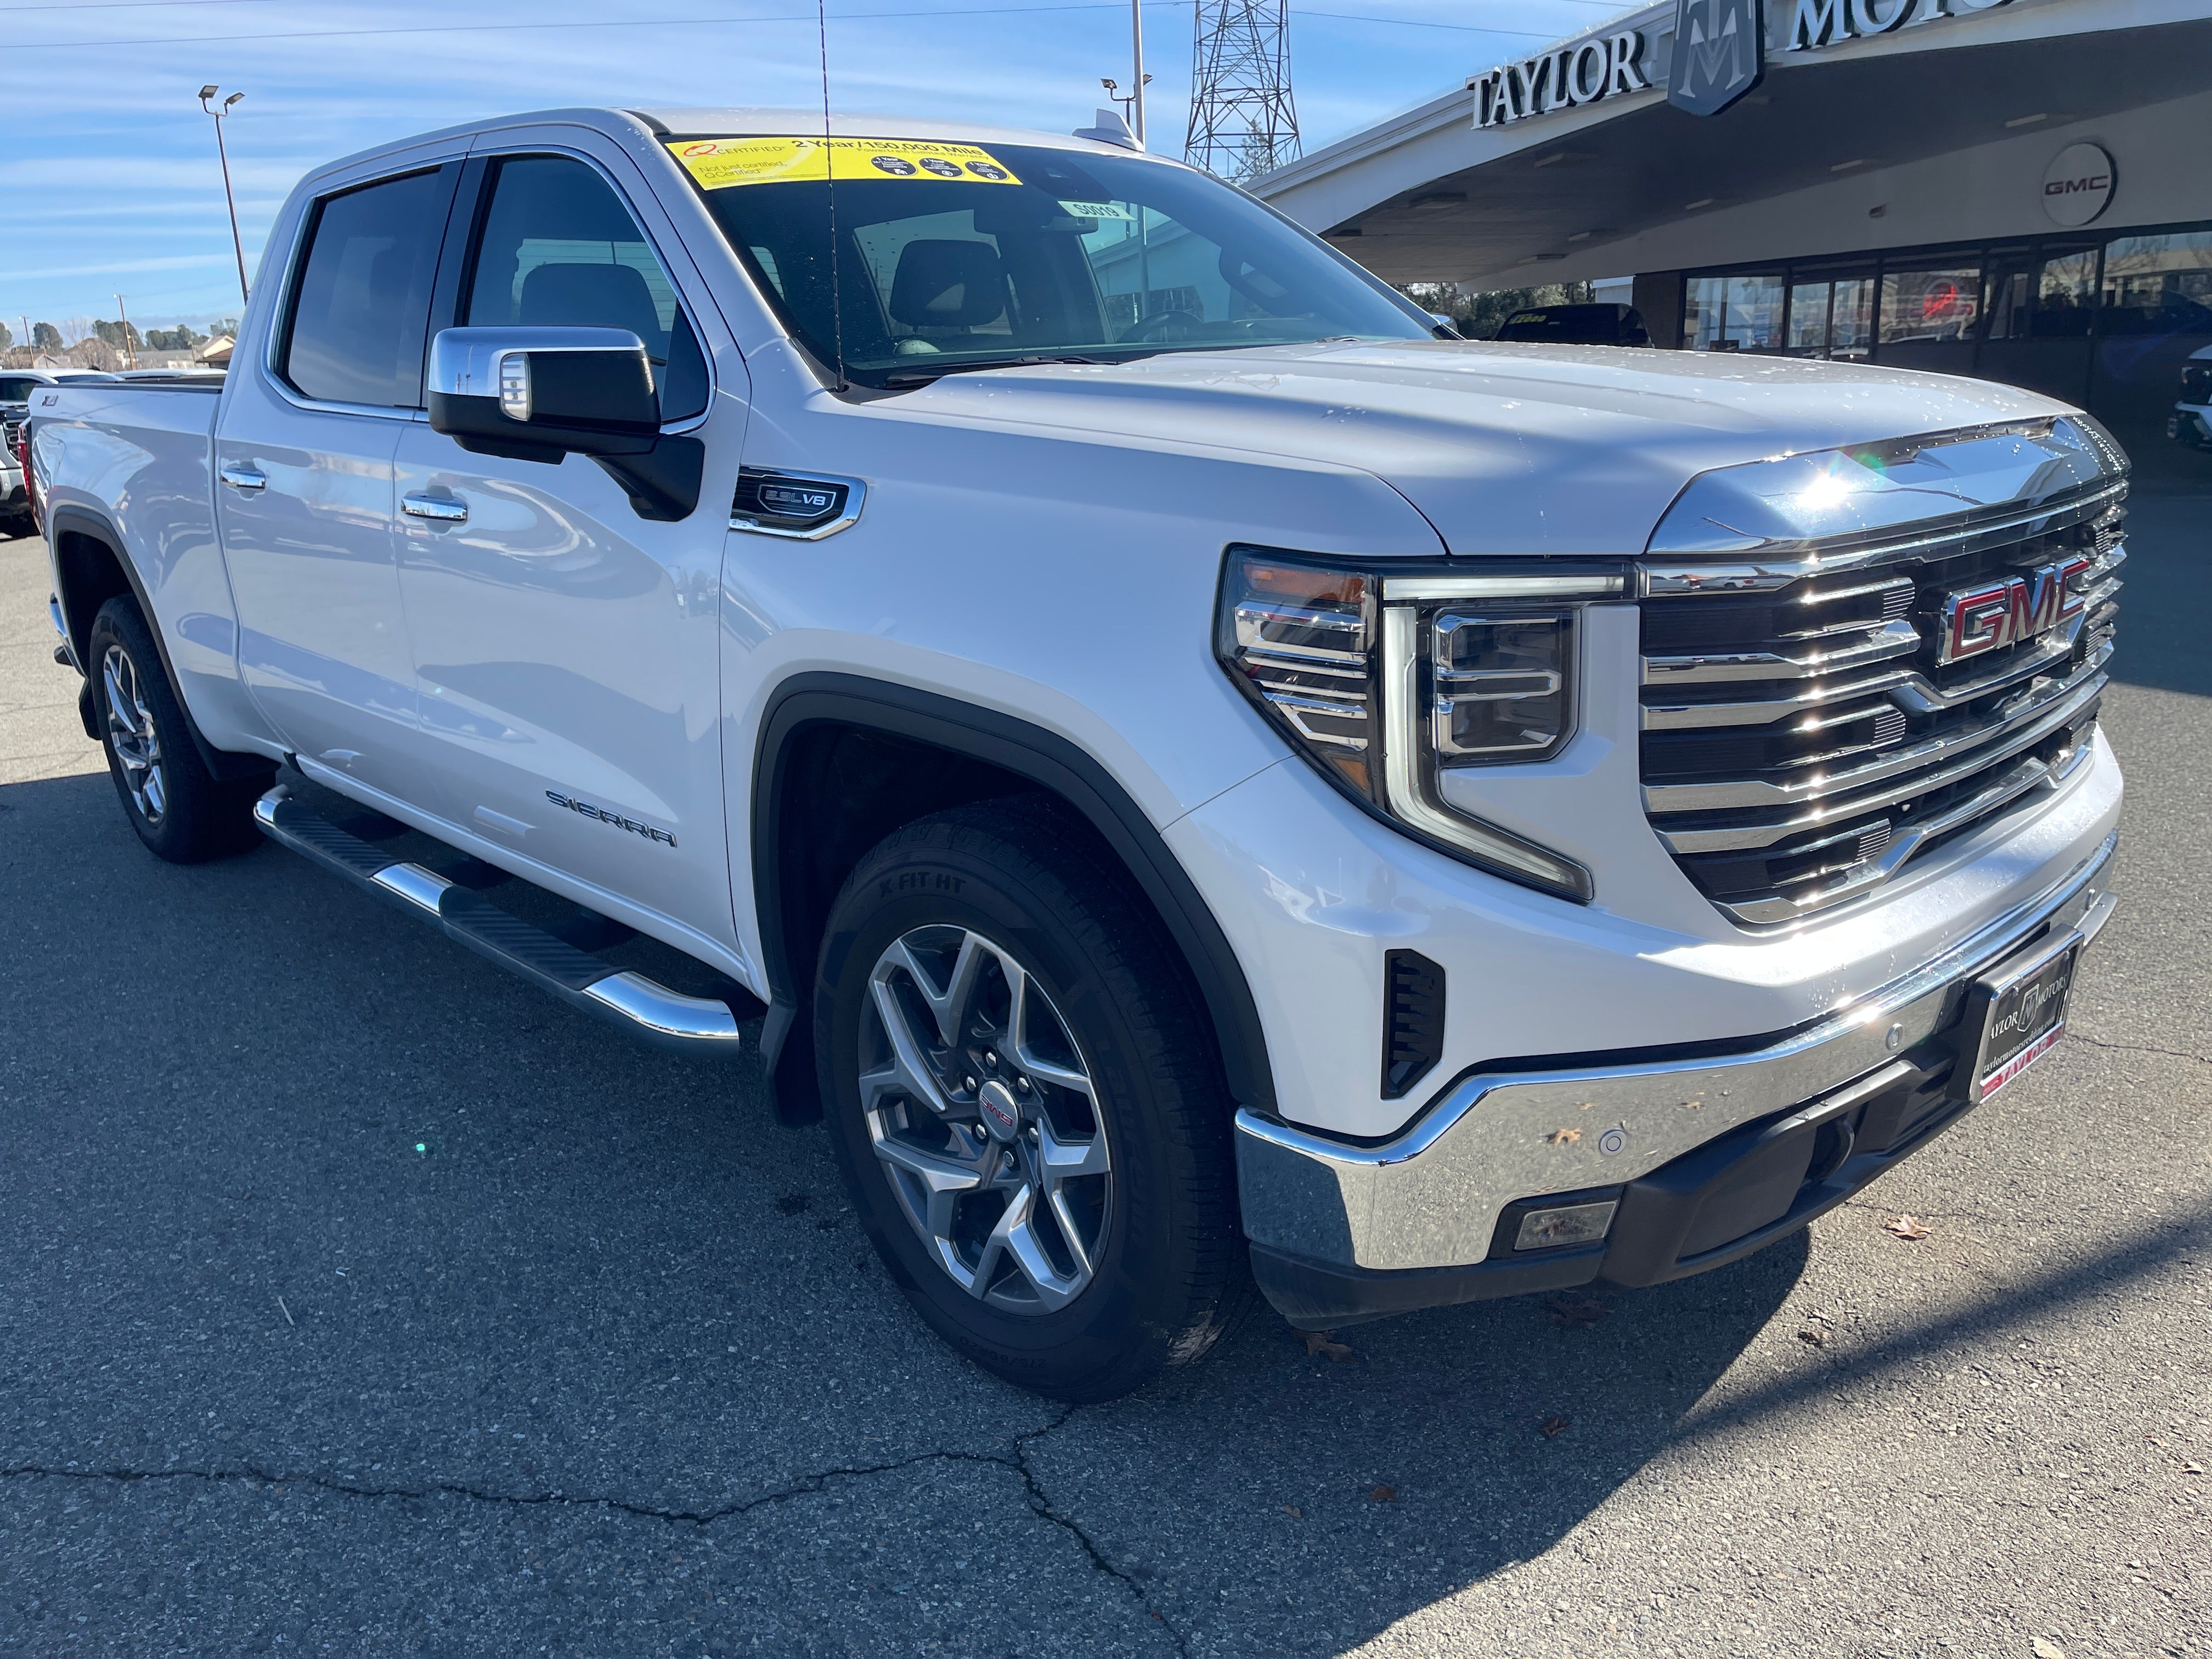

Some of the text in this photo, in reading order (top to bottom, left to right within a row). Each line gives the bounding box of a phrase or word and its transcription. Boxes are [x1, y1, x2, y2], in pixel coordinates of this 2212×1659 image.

[1465, 30, 1649, 130] TAYLOR
[717, 146, 783, 155] CERTIFIED
[940, 145, 984, 155] Mile
[723, 163, 742, 172] just
[2045, 175, 2108, 195] GMC
[1938, 554, 2090, 666] GMC
[545, 788, 678, 848] SIERRA
[879, 871, 967, 899] X FIT HT
[1990, 1011, 2018, 1040] AYLOR
[2001, 1038, 2049, 1084] TAYLOR
[980, 1093, 1013, 1127] GMC
